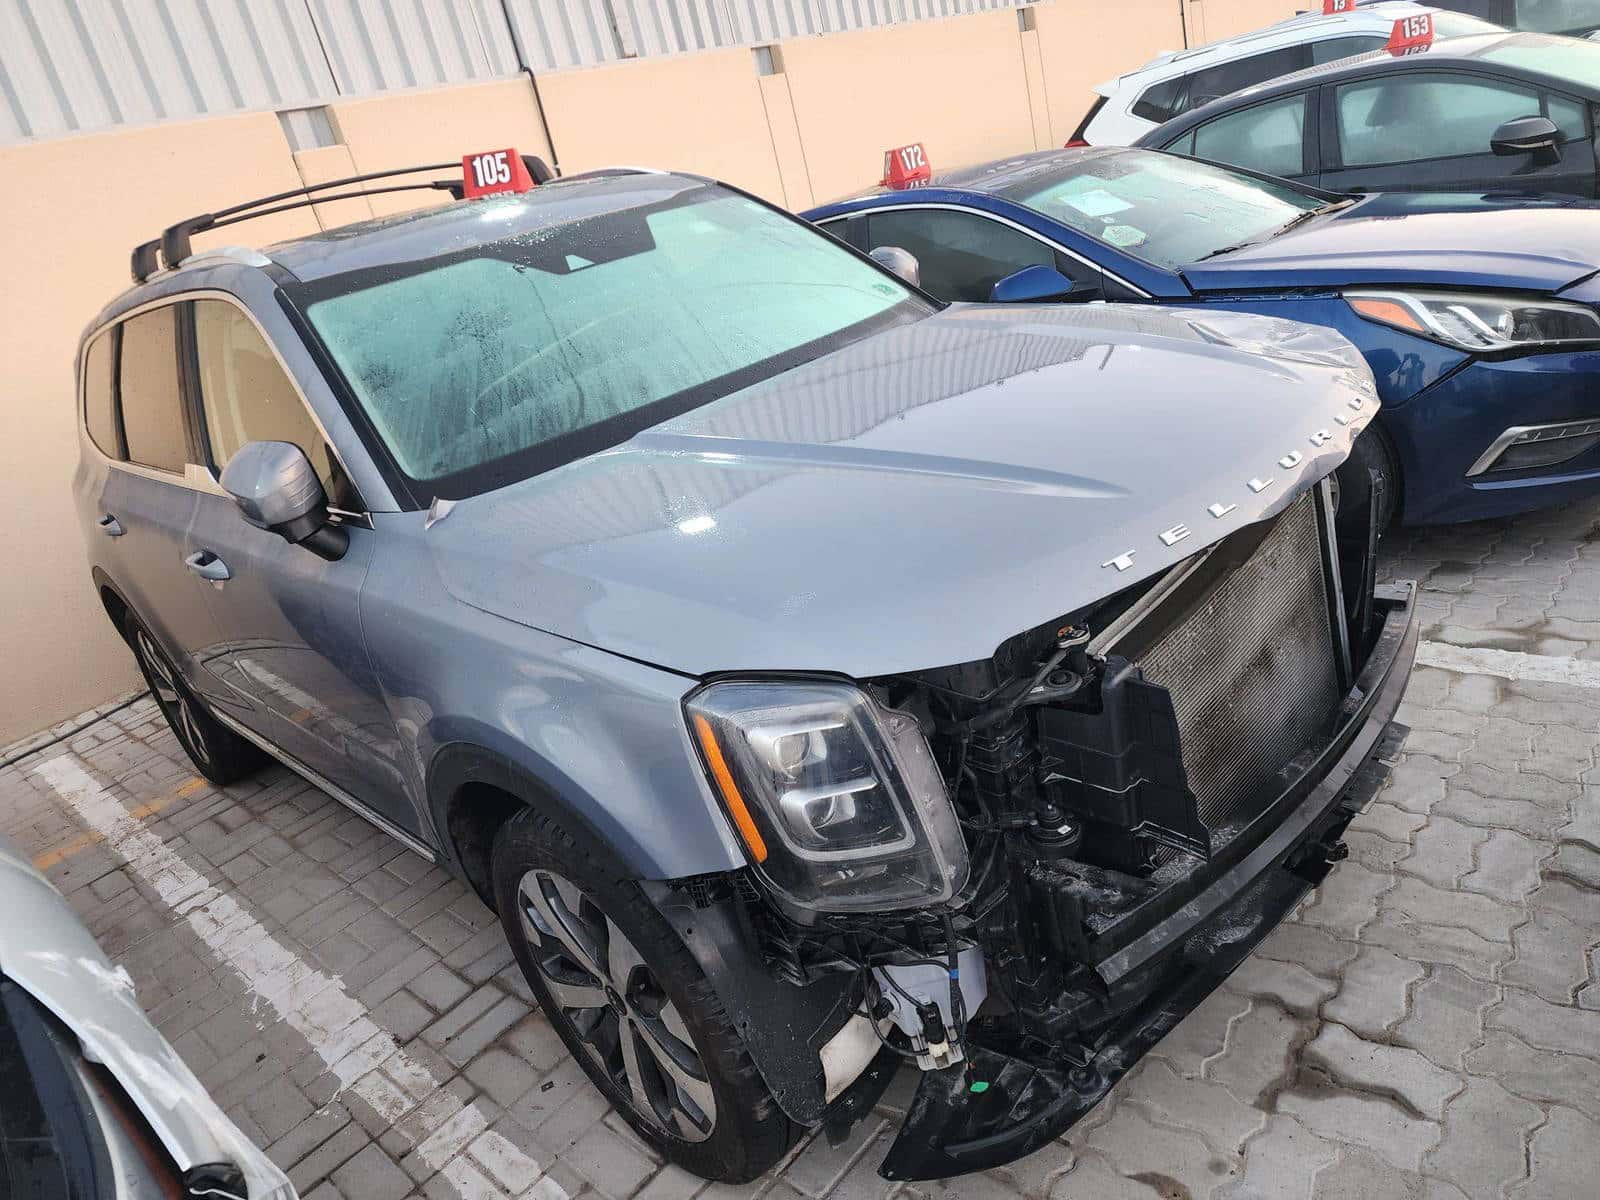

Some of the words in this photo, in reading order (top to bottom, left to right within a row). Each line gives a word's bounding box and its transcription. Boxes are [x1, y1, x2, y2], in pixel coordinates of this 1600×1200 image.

[1403, 15, 1429, 38] 153
[472, 152, 511, 187] 105
[901, 144, 925, 170] 172
